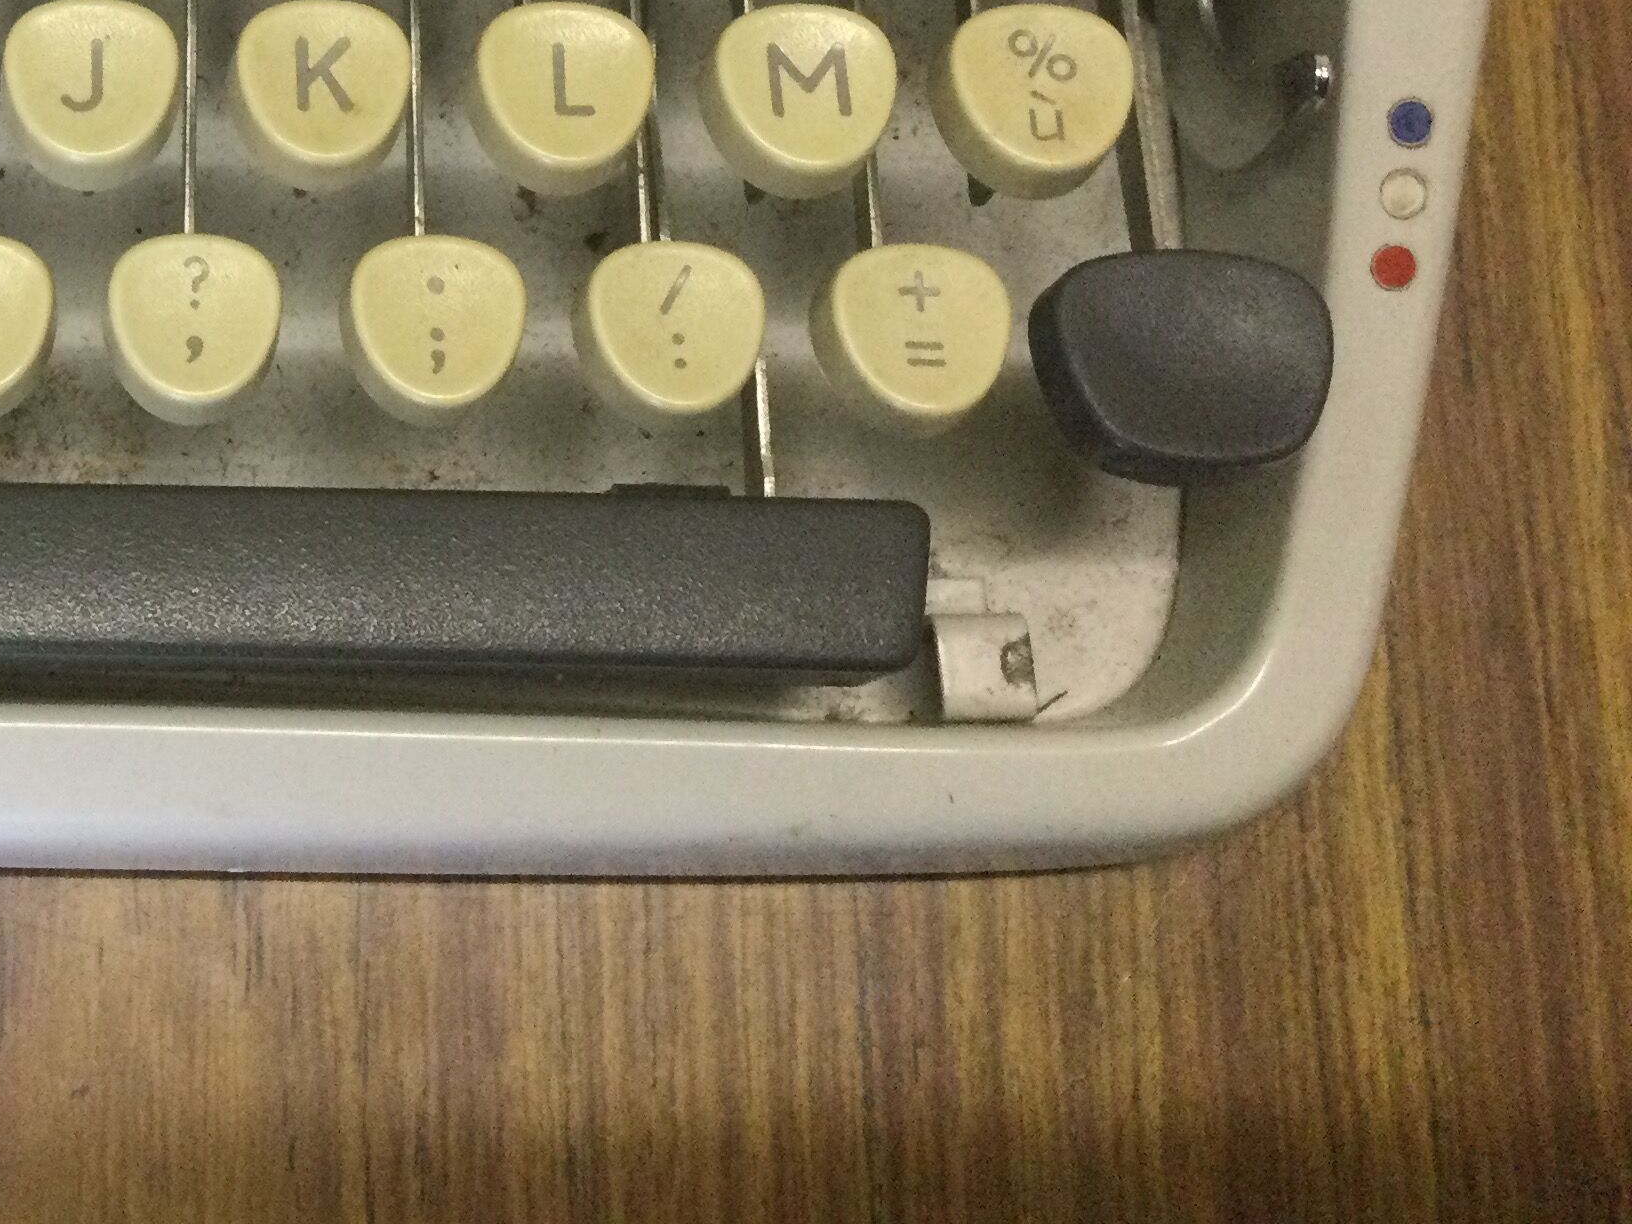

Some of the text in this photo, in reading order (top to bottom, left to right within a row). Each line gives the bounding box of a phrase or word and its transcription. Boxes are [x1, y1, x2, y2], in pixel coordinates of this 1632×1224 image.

[60, 39, 103, 112] J
[295, 36, 355, 113] K
[552, 43, 596, 117] L
[766, 43, 852, 118] M
[1008, 29, 1077, 82] %
[1029, 90, 1065, 141] ù
[184, 256, 209, 309] ?
[660, 265, 691, 315] /
[898, 271, 940, 312] +
